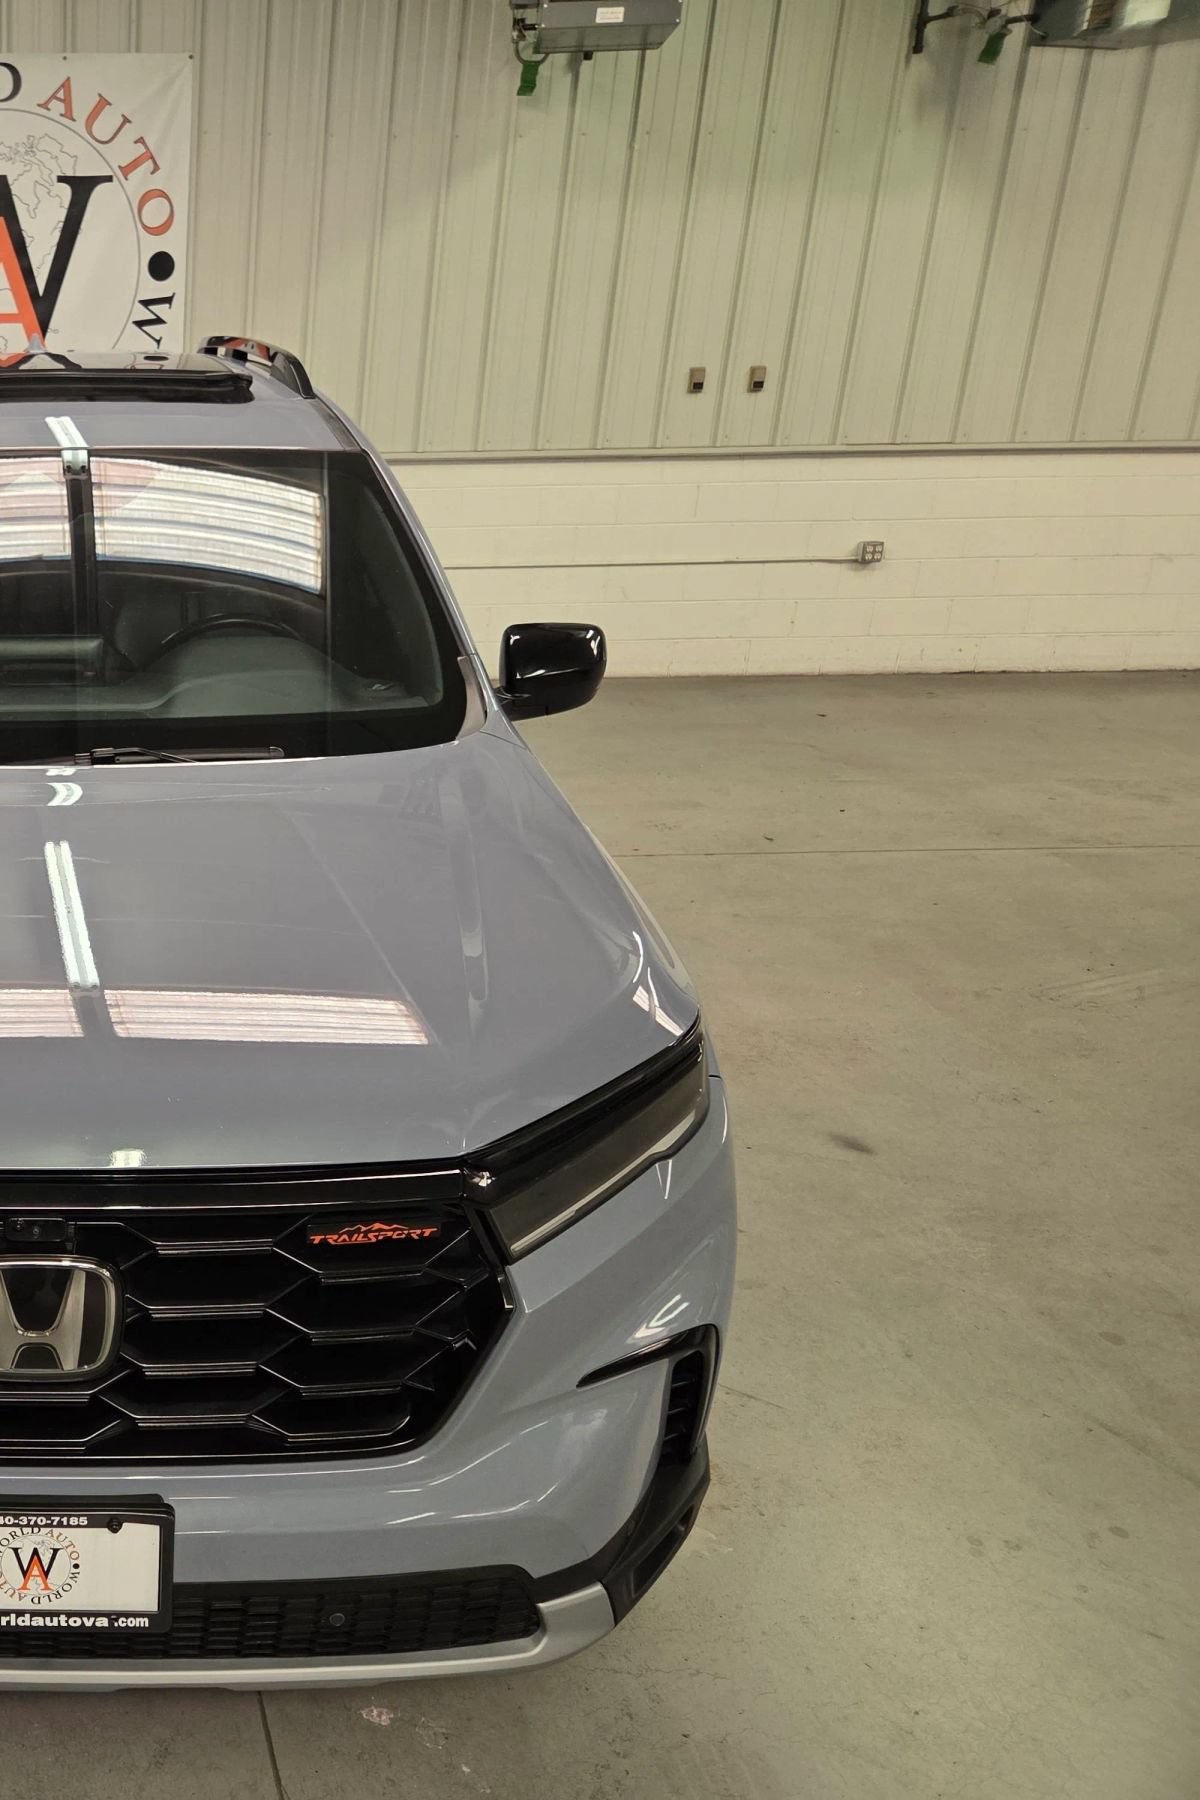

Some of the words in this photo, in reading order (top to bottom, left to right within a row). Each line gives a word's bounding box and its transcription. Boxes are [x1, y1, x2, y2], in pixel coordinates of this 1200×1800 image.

[37, 76, 175, 236] AUTO
[310, 1228, 438, 1245] TRAILSPORT
[45, 1528, 80, 1561] AUTO
[31, 1571, 80, 1605] WORLD
